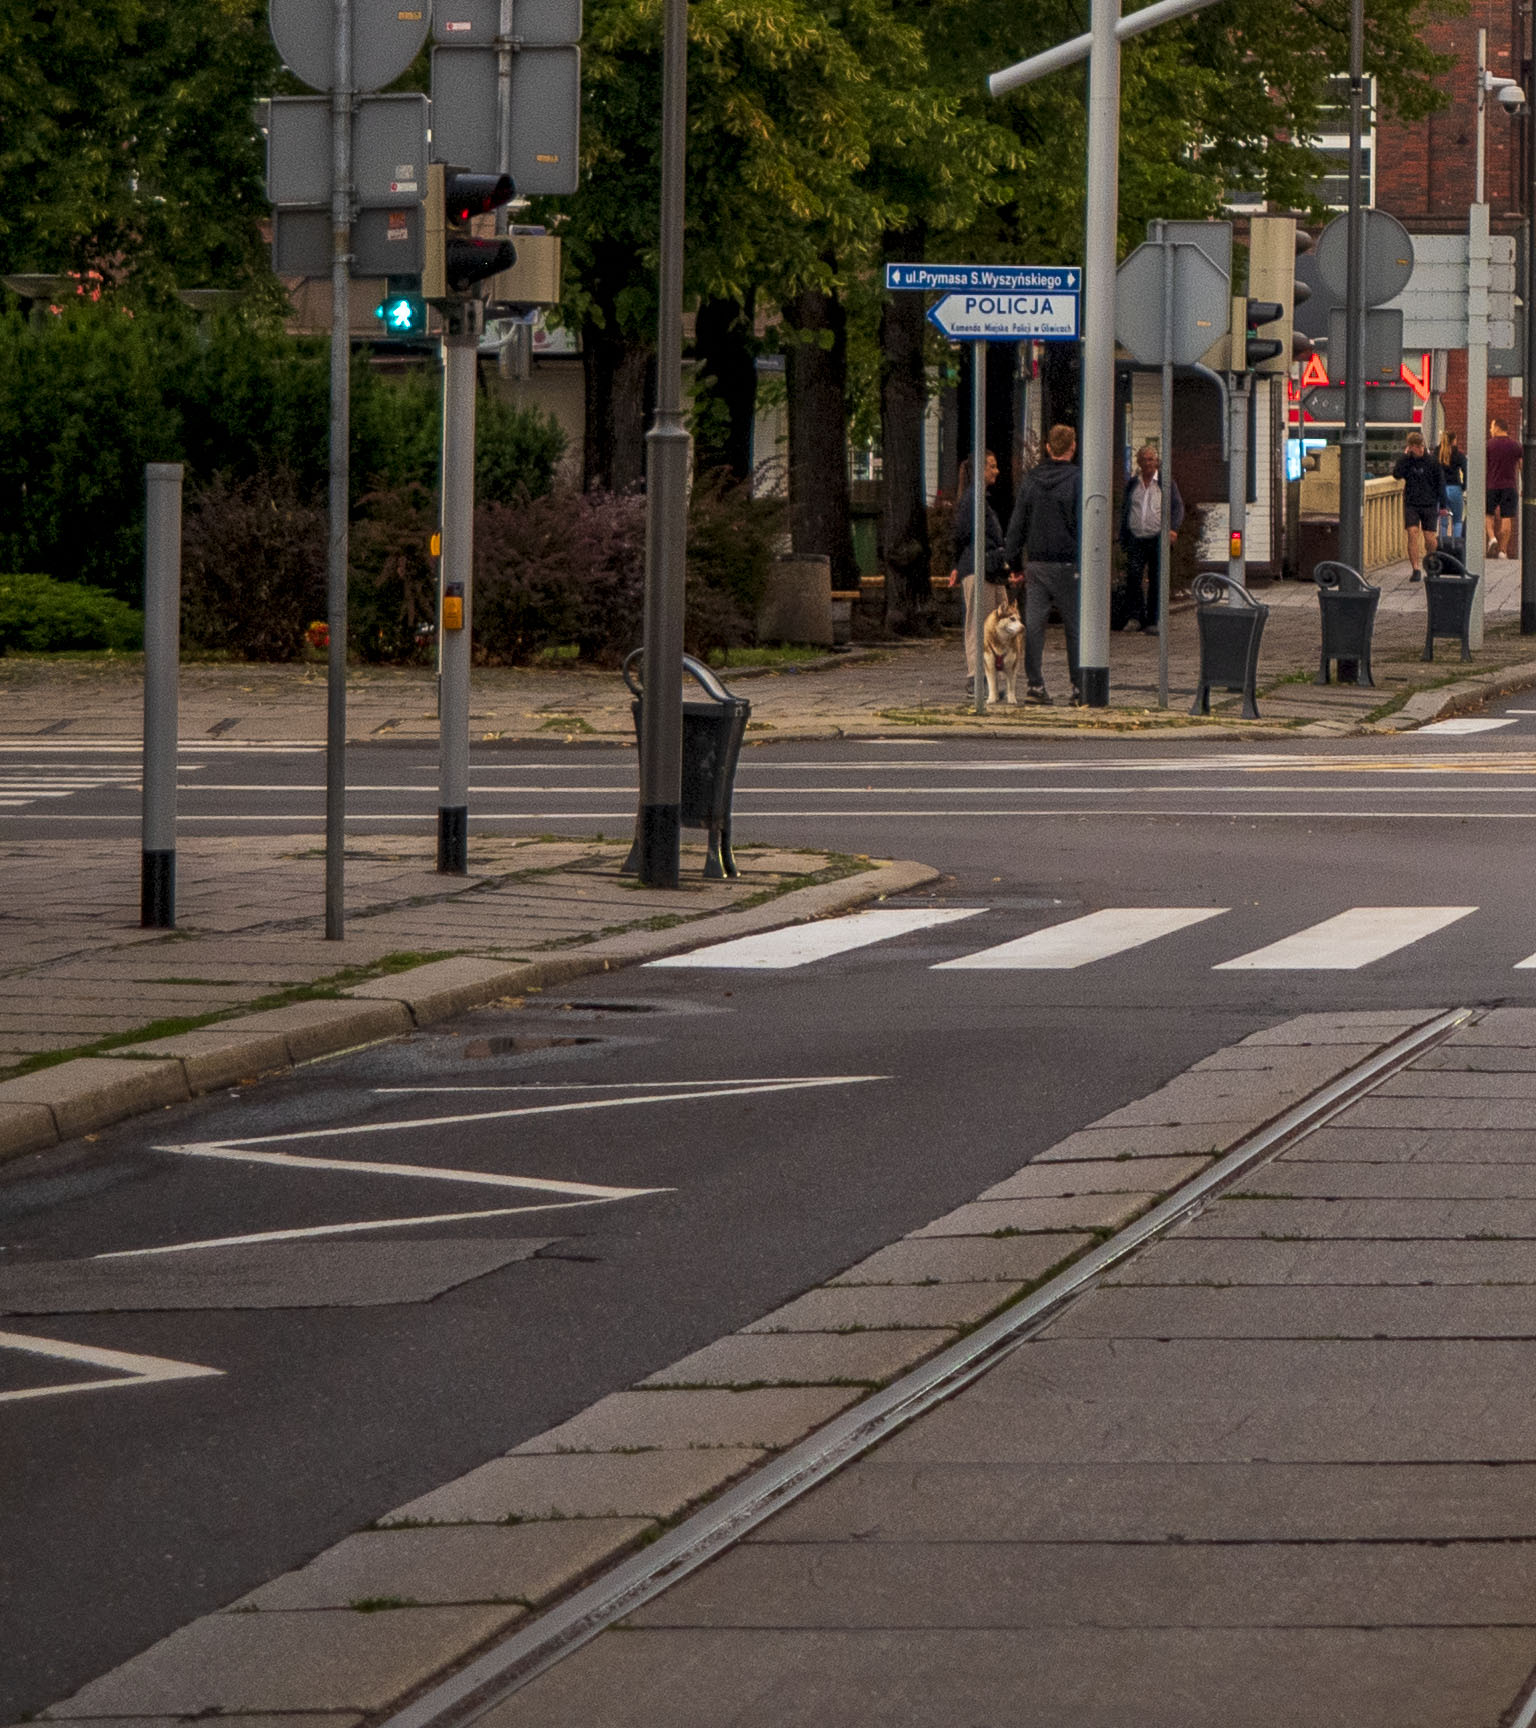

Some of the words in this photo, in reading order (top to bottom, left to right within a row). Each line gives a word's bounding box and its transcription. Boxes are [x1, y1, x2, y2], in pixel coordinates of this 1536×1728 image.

[965, 297, 1054, 315] POLICJA
[950, 323, 981, 333] Komenda
[984, 323, 1010, 334] Miejska
[1041, 324, 1072, 334] Gliwicach
